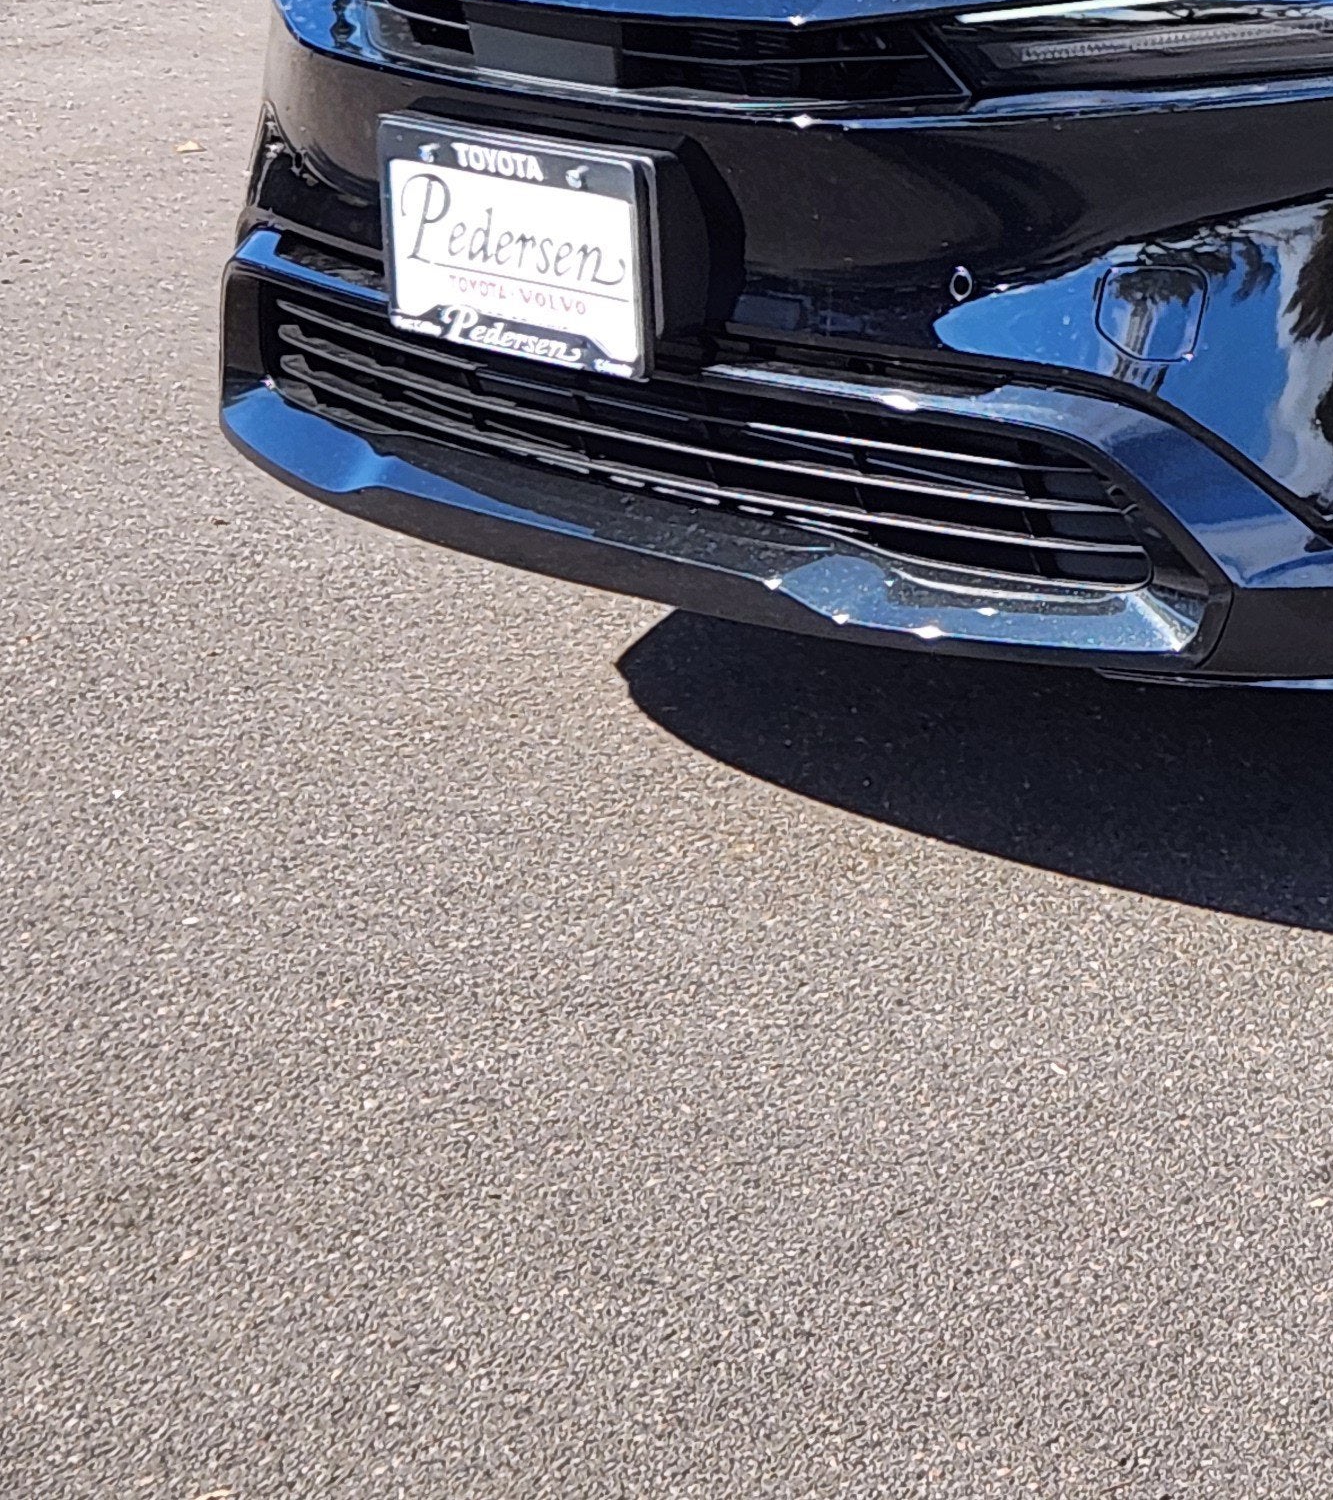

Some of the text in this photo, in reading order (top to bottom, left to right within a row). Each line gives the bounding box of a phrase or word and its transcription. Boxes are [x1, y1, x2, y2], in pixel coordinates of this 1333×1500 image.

[450, 142, 544, 182] TOYOTA
[400, 173, 626, 286] Pedersen
[518, 288, 587, 315] VOLVO
[440, 304, 582, 362] Pedersen
